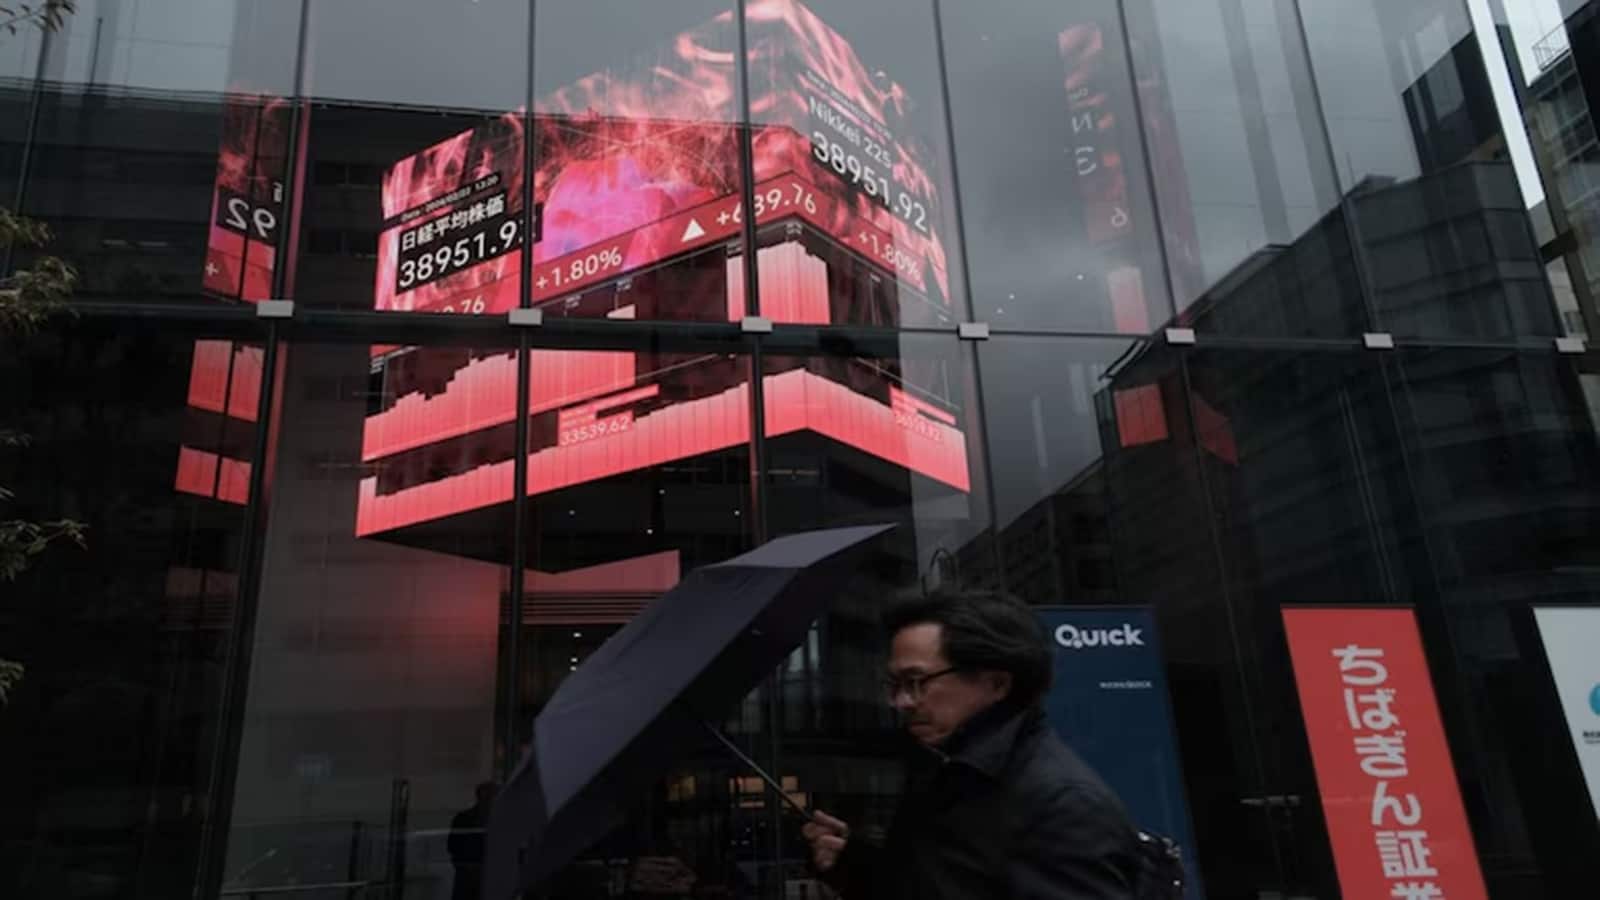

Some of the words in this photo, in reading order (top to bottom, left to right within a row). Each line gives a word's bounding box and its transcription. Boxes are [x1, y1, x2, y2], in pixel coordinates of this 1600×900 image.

[809, 98, 861, 147] Nikkei
[864, 138, 892, 168] 225
[812, 131, 928, 233] 38951.92
[401, 194, 505, 252] 日経平均株価
[536, 247, 623, 289] +1.80%
[858, 229, 921, 282] +1.80%
